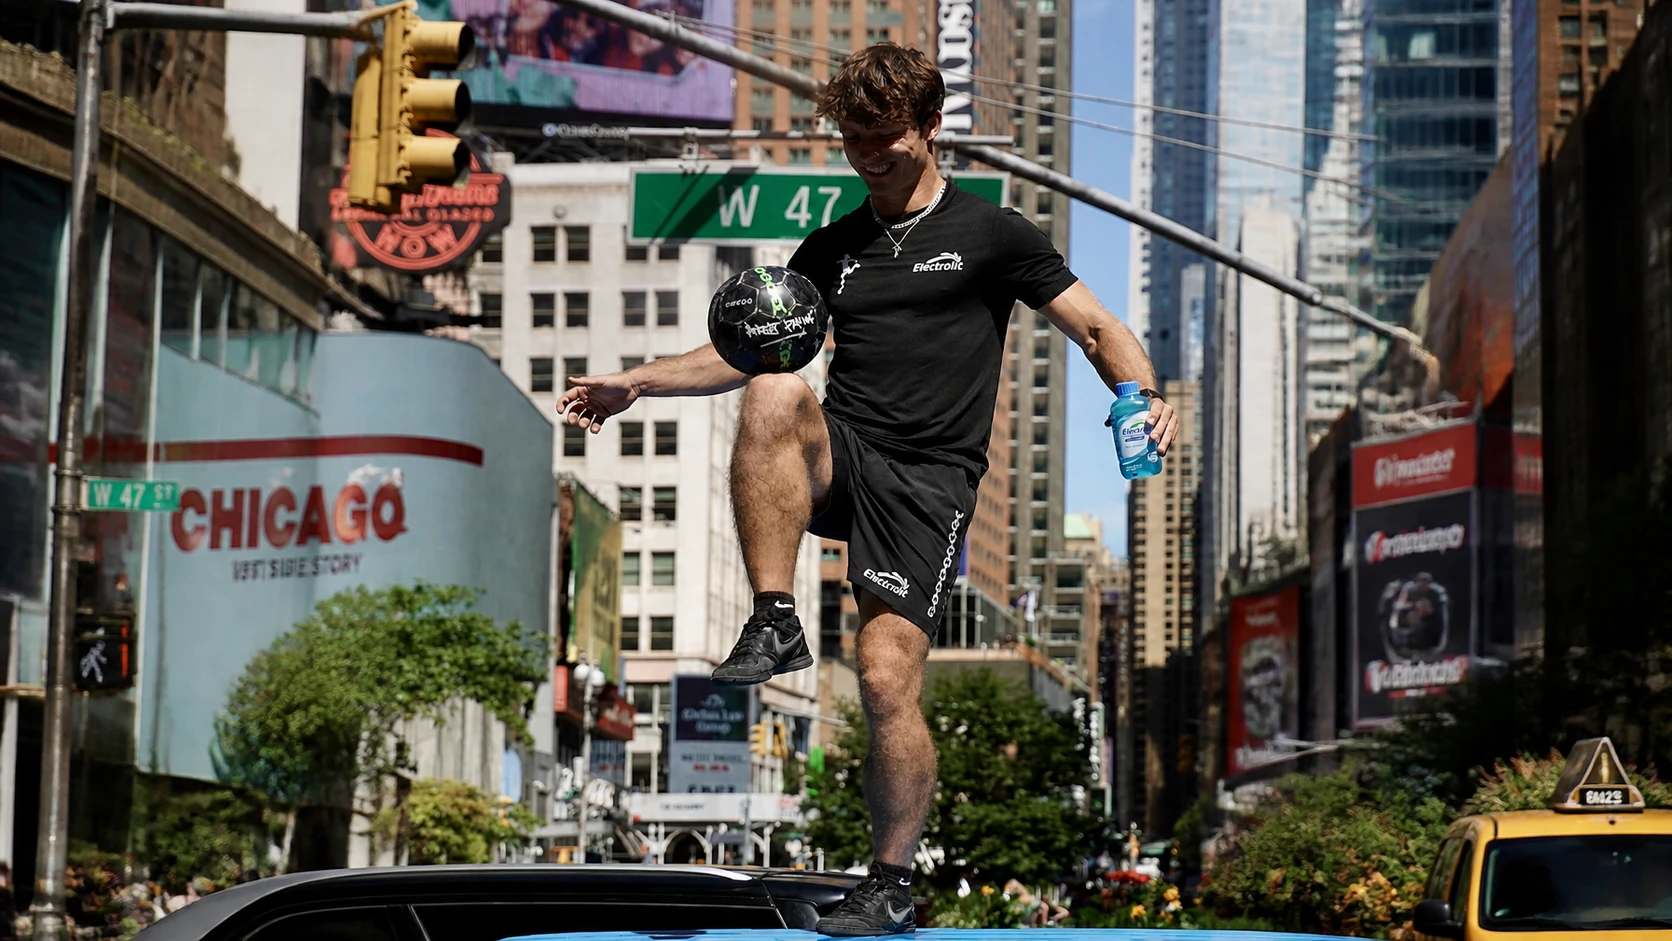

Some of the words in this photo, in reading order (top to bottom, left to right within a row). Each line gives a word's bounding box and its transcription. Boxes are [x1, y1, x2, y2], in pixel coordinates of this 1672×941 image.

[718, 185, 760, 228] W
[784, 186, 842, 228] 47
[93, 482, 112, 506] W
[120, 482, 146, 508] 47
[153, 484, 173, 500] ST
